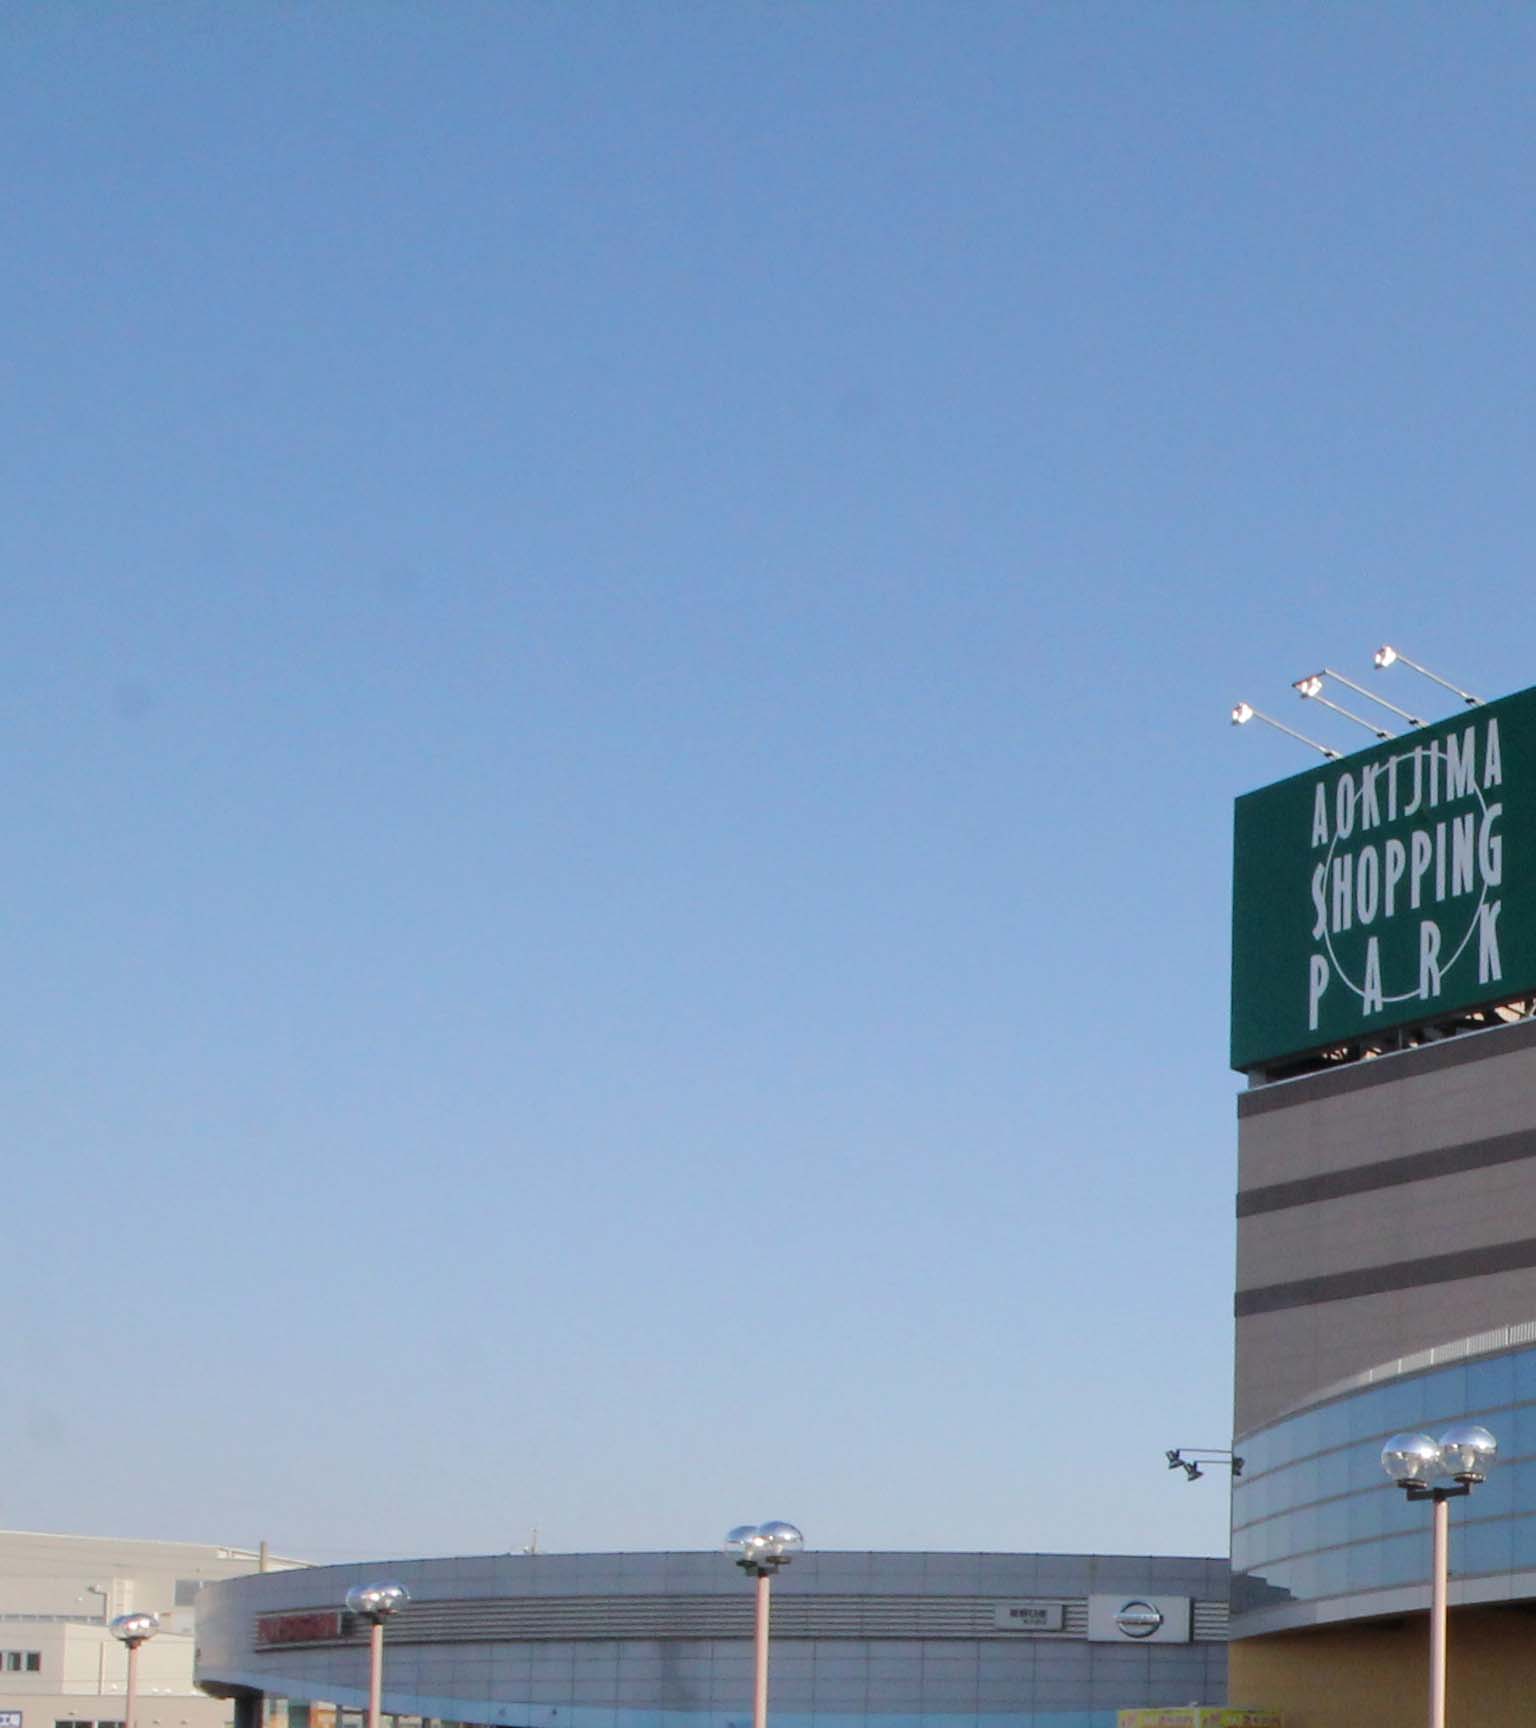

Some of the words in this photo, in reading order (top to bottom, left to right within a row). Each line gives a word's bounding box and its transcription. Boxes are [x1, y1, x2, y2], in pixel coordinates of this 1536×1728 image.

[1311, 718, 1502, 848] AOKIJIMA
[1311, 803, 1502, 941] SHOPPING
[1308, 900, 1502, 1031] PARK
